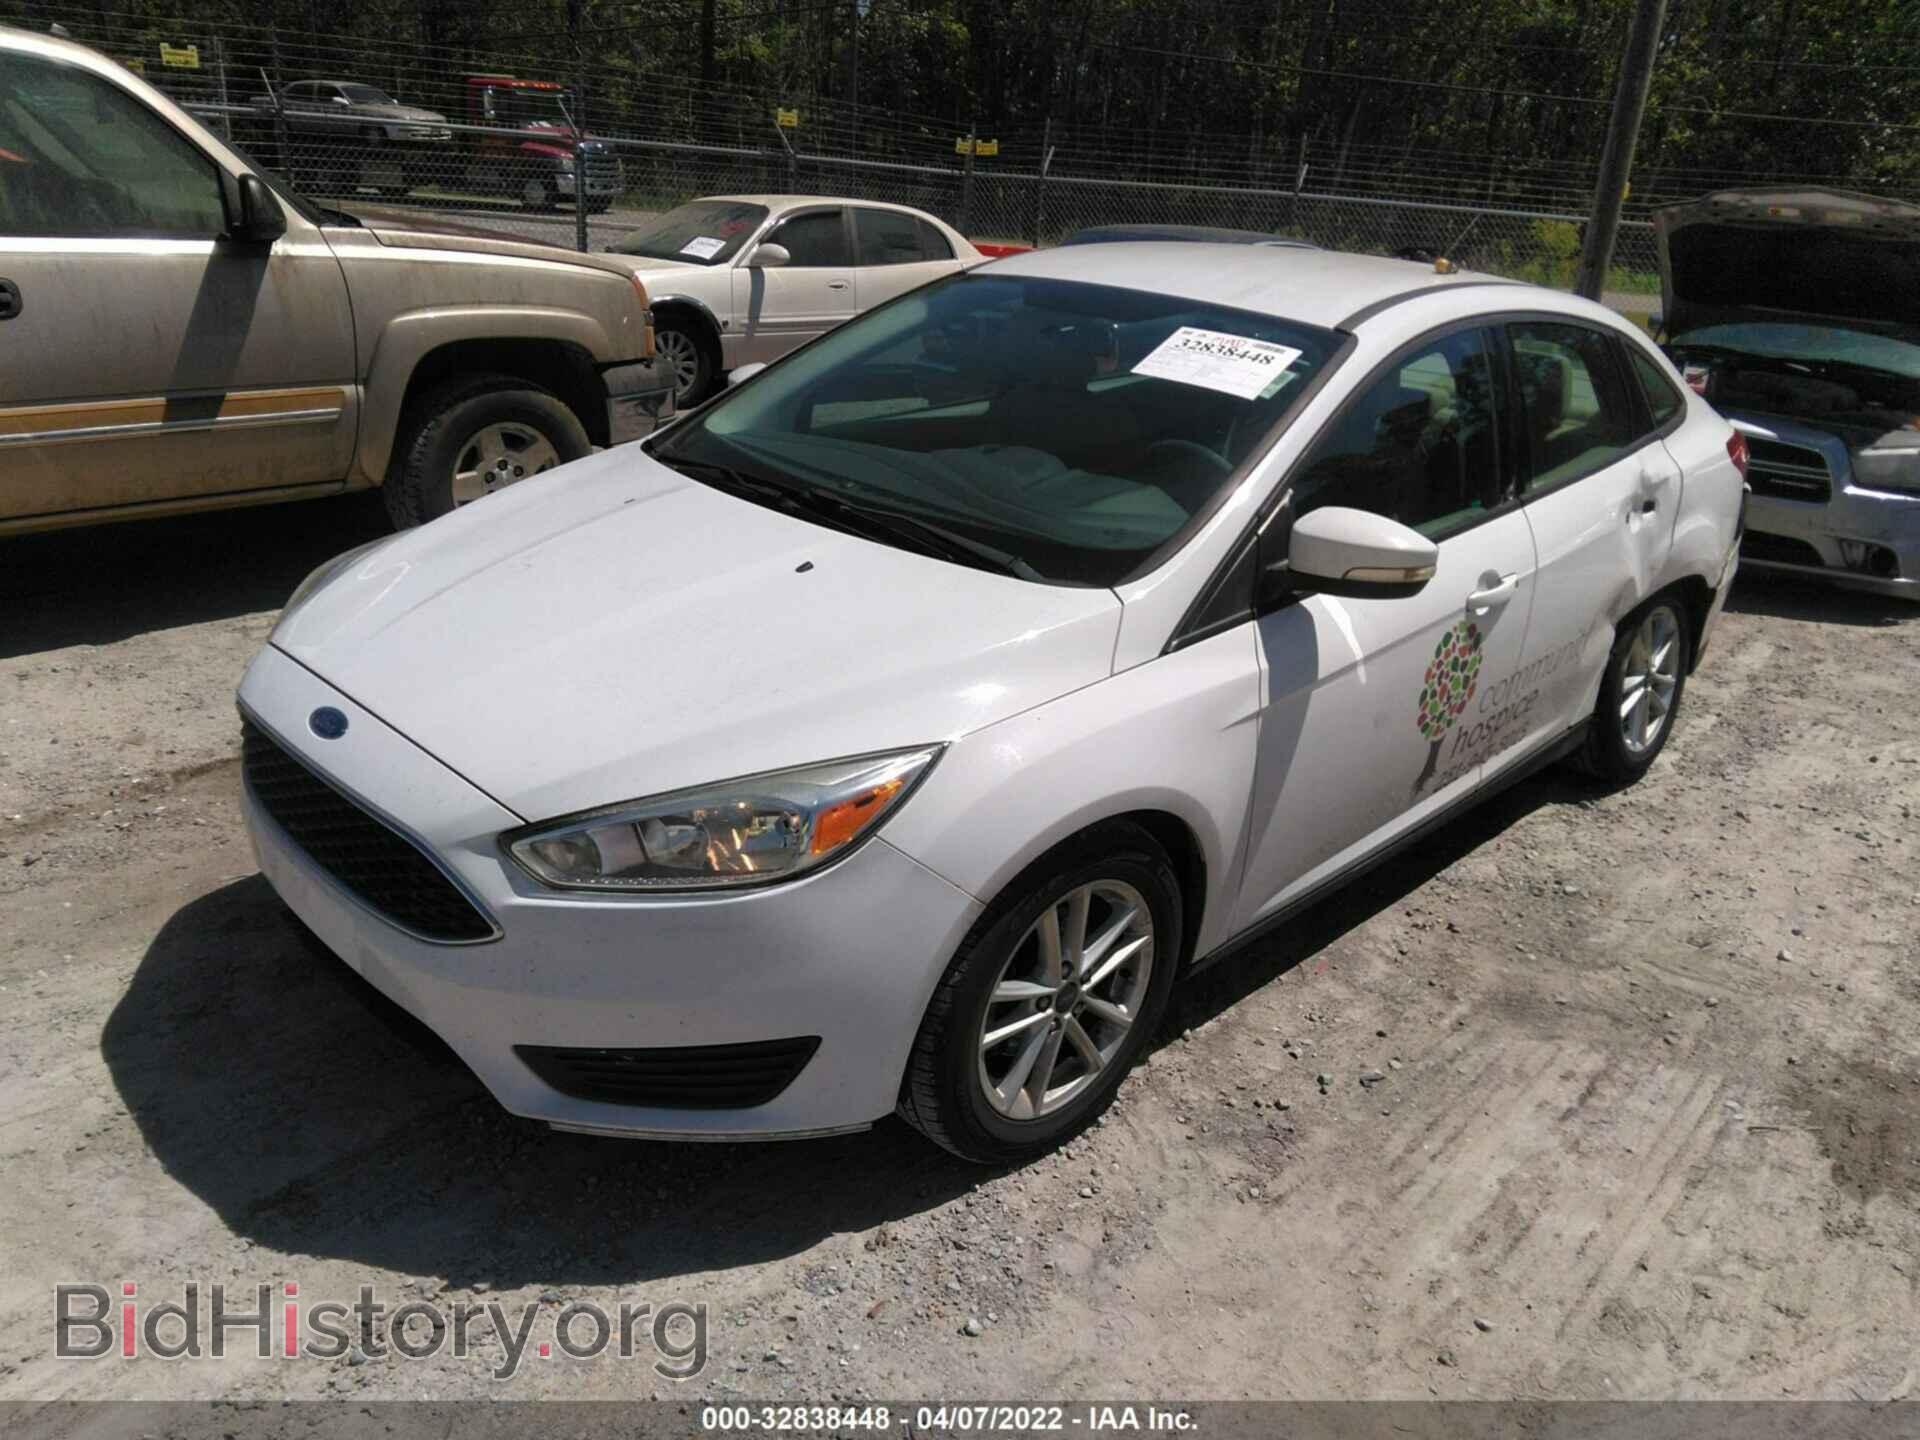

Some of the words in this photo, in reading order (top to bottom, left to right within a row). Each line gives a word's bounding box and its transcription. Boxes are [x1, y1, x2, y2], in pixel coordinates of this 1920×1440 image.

[1174, 338, 1275, 366] 32838448
[1478, 629, 1590, 715] communi
[1449, 689, 1540, 760] hospice
